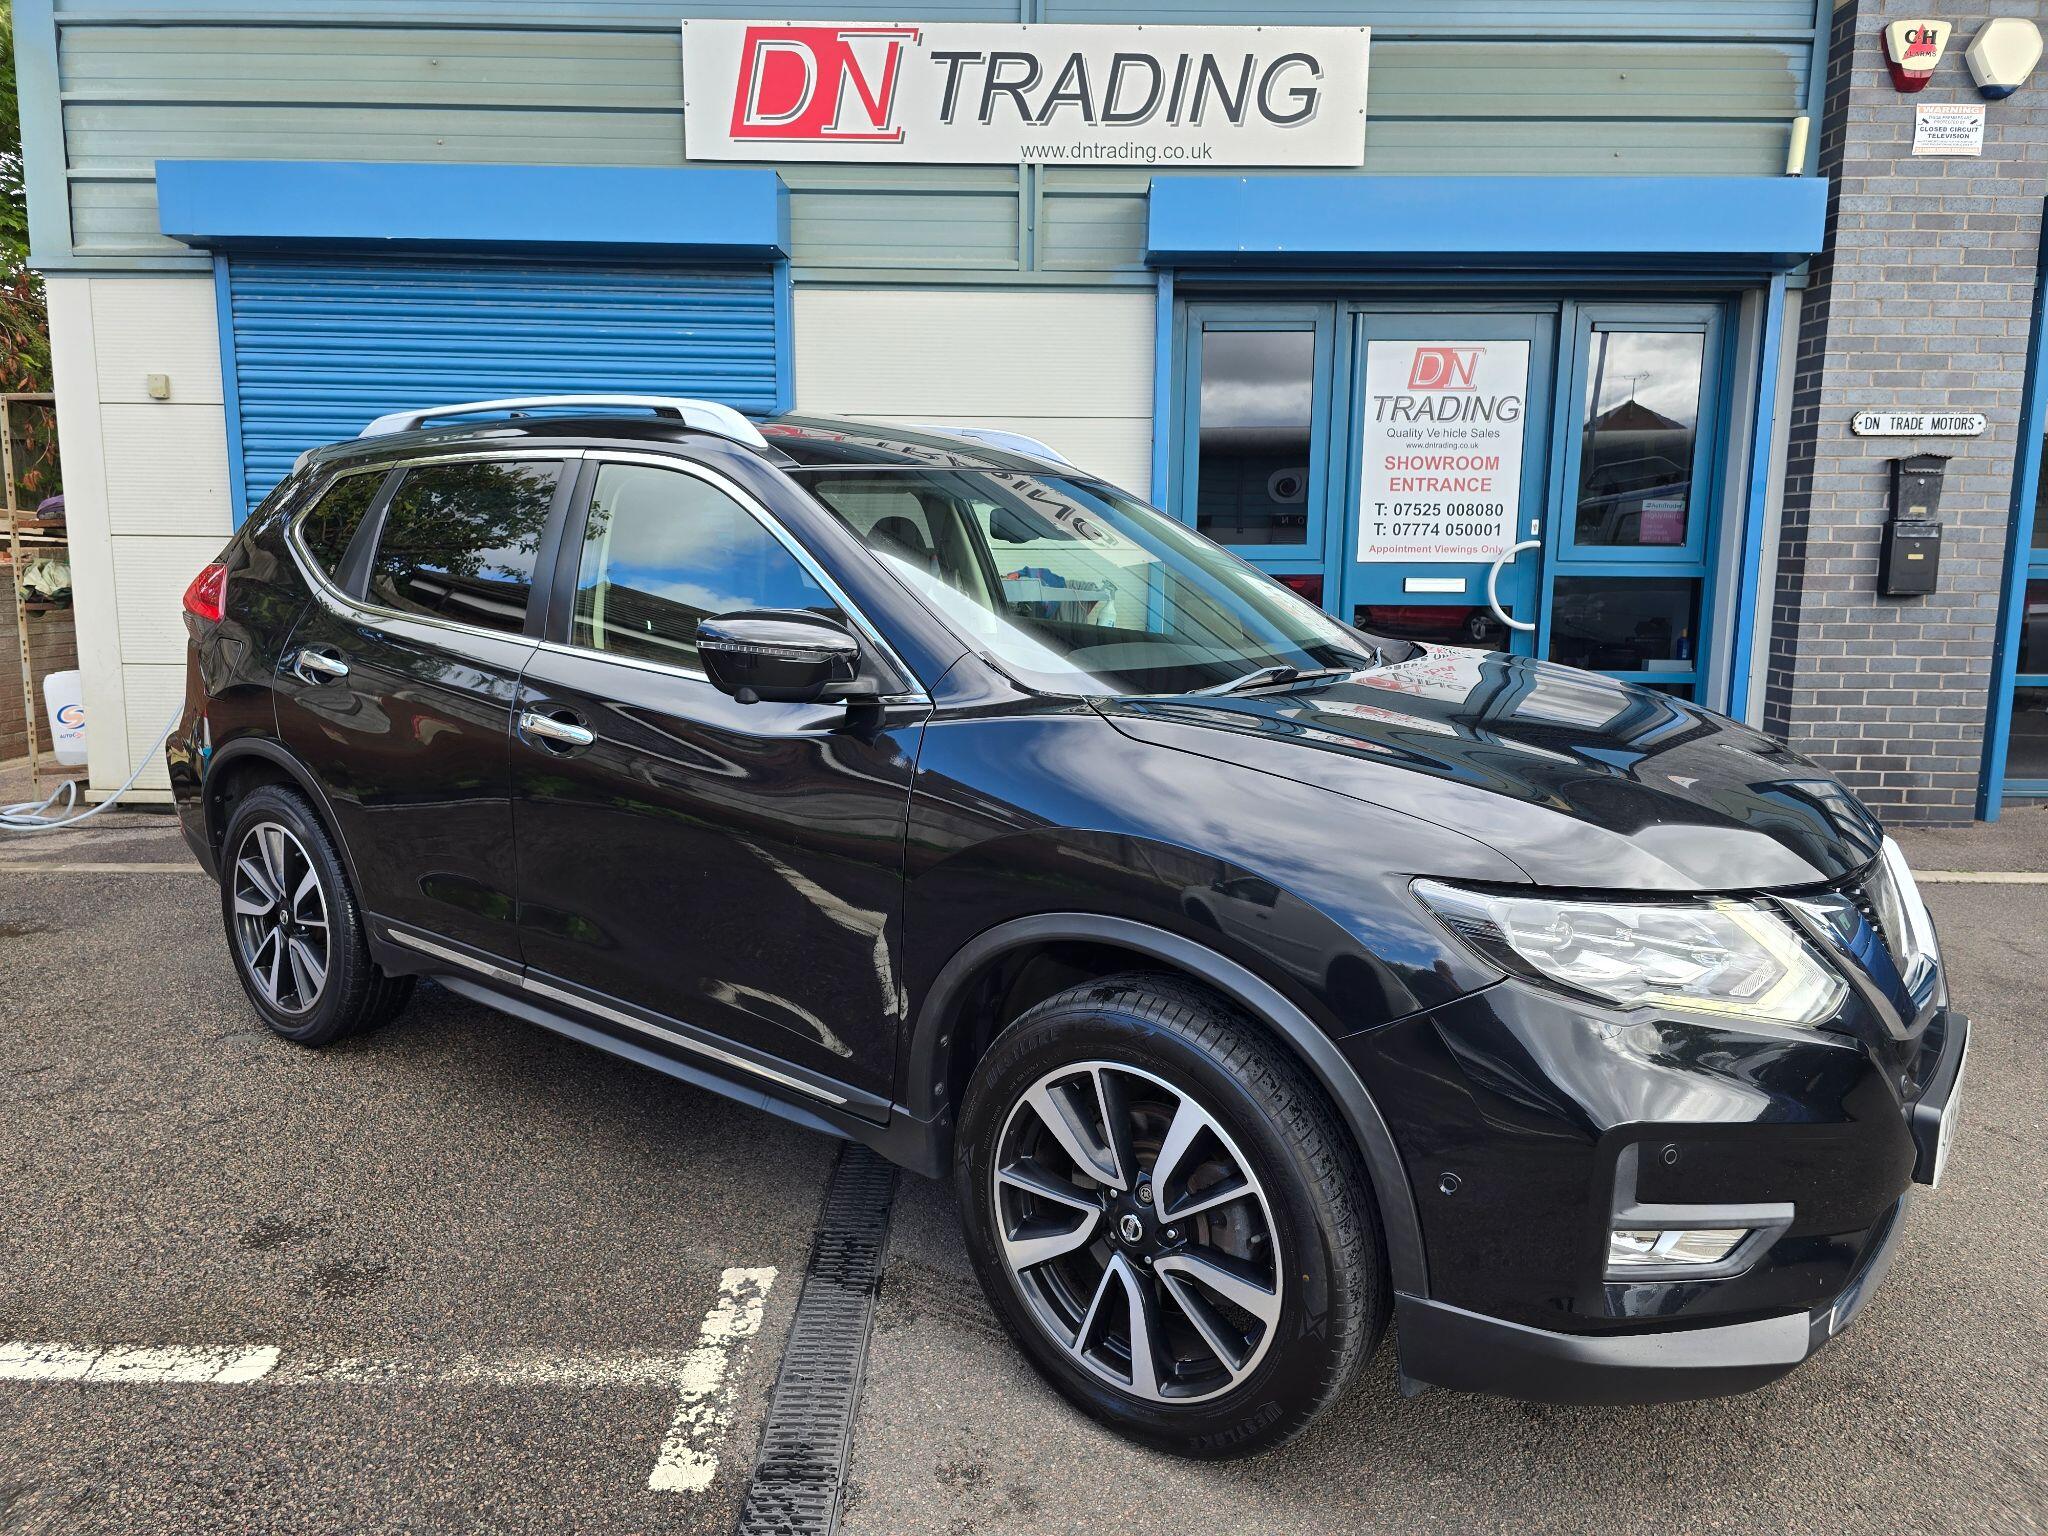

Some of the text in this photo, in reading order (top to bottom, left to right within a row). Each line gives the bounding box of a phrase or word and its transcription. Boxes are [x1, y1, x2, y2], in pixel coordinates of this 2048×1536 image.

[730, 27, 1325, 142] DN TRADING
[1924, 106, 1980, 114] WARNING
[1020, 142, 1212, 162] www.dntrading.co.uk
[1407, 347, 1487, 391] DN
[1374, 395, 1522, 423] TRADING
[1864, 416, 1975, 431] DN TRADE MOTORS
[1386, 428, 1501, 440] Quality Vehicle Sales
[1405, 442, 1479, 450] www.dntrading.co.uk
[1384, 456, 1500, 471] SHOWROOM
[1389, 477, 1492, 492] ENTRANCE
[1375, 503, 1504, 516] T: 07525 008080
[1373, 523, 1501, 536] T: 07774 050001
[1369, 544, 1503, 555] Appointment Viewings Only
